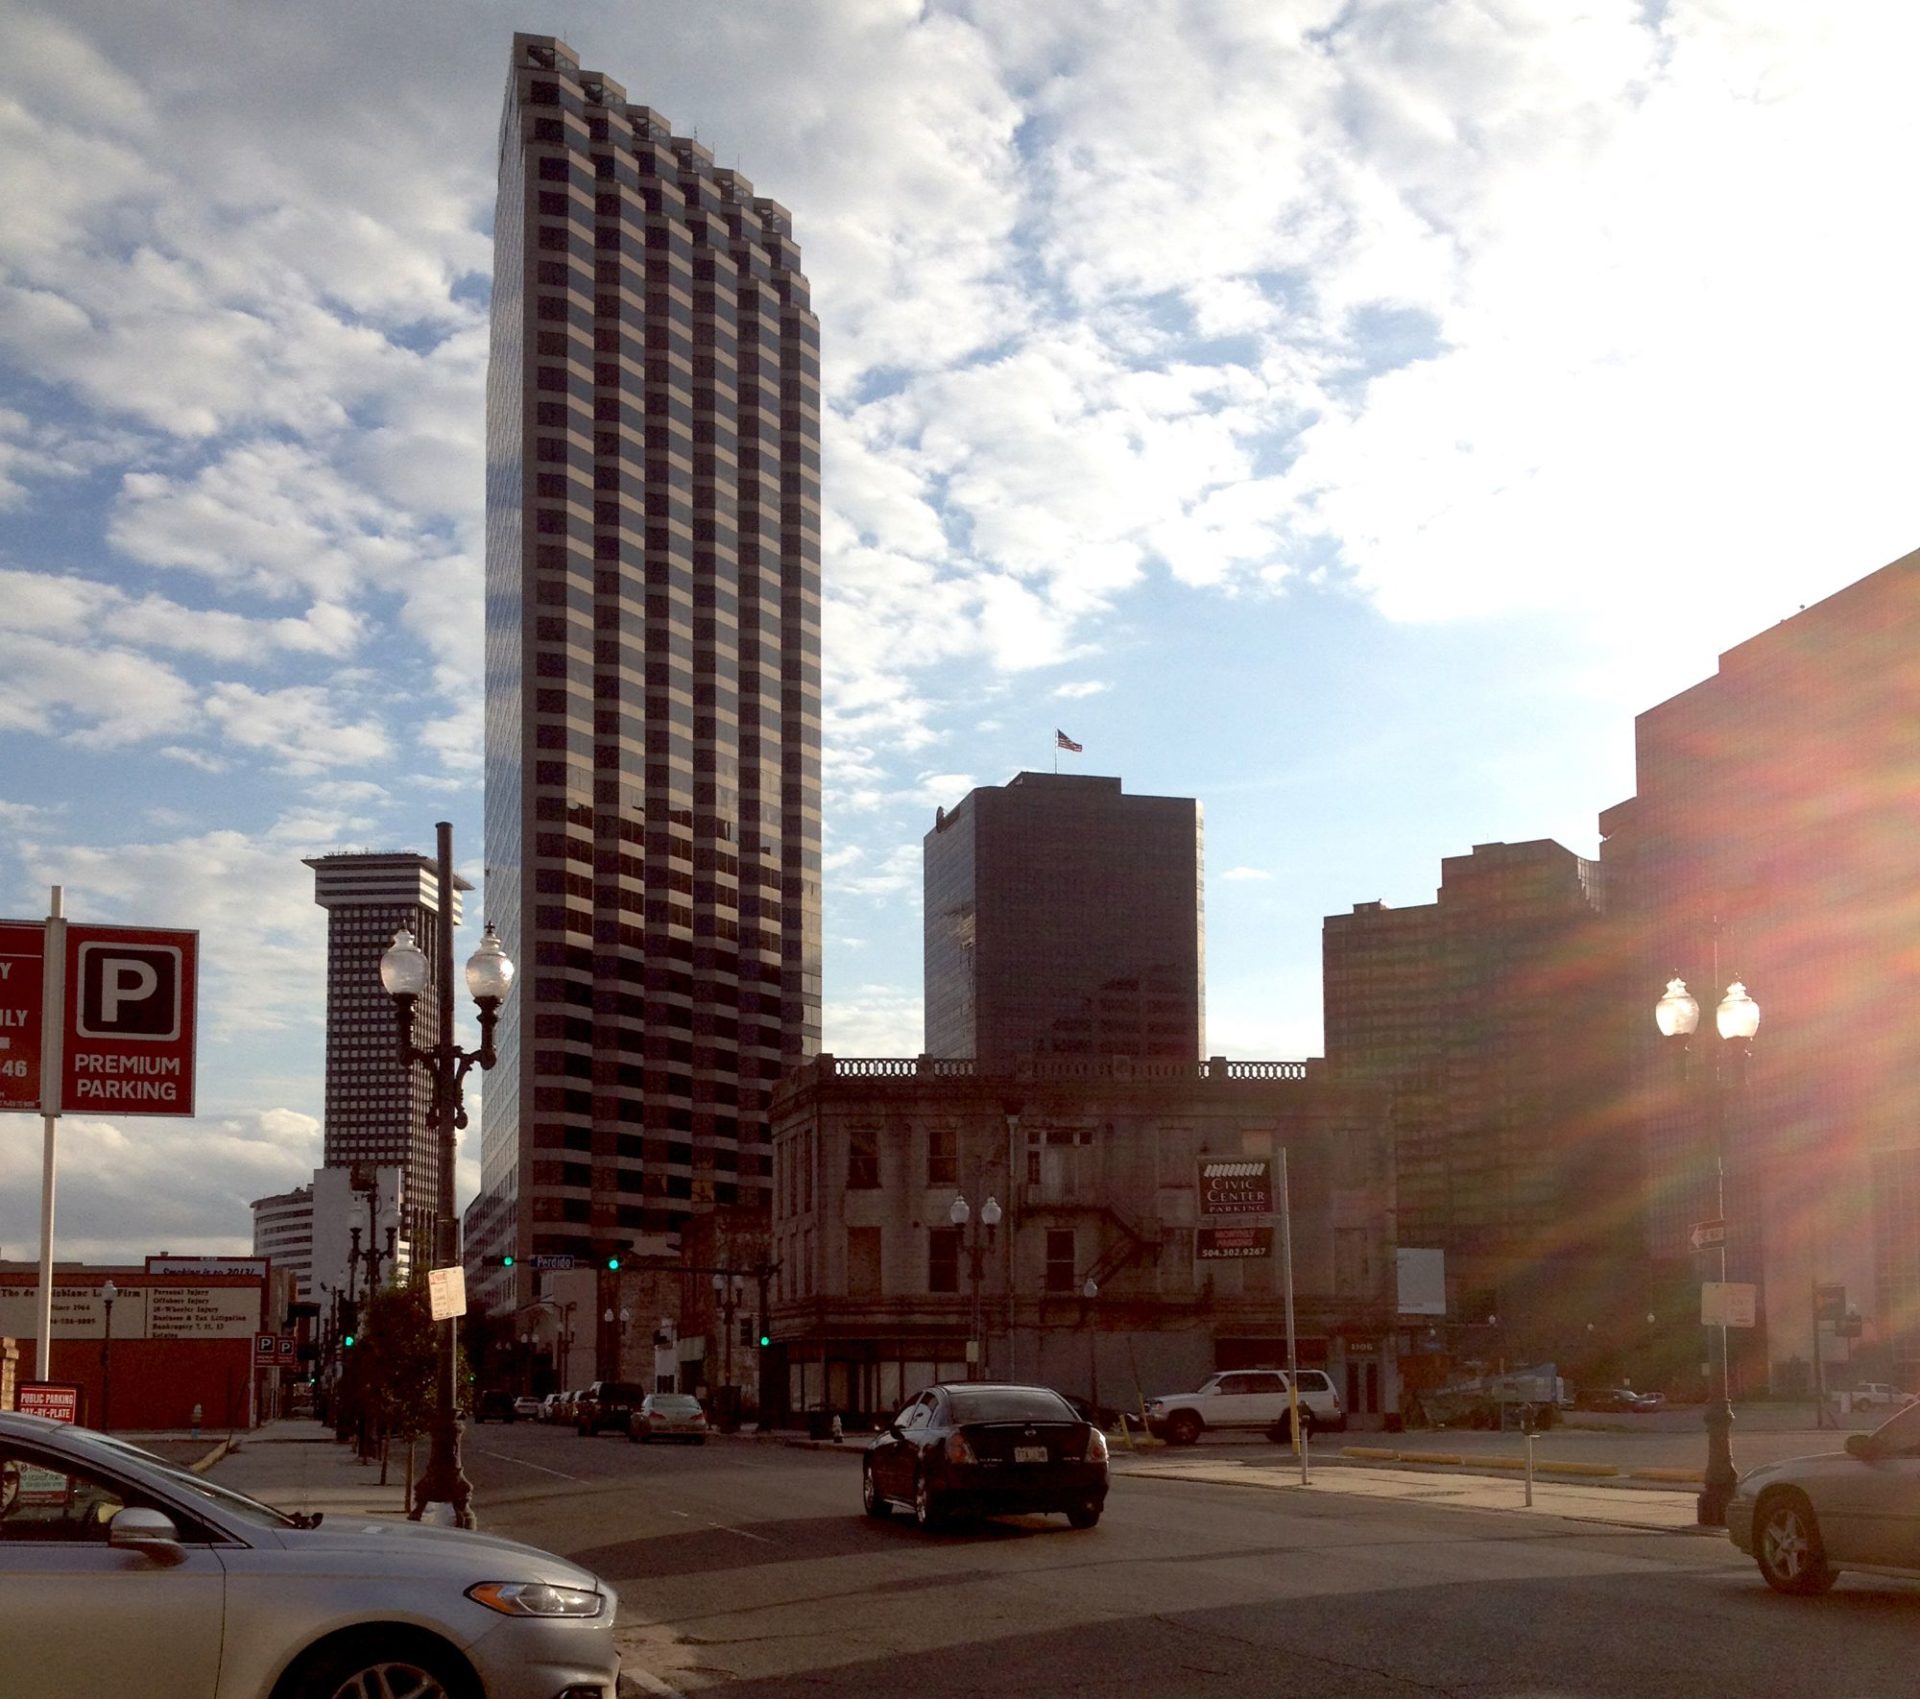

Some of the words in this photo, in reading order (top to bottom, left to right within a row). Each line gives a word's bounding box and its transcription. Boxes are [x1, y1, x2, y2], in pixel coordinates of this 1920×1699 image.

[101, 958, 158, 1022] P
[74, 1053, 180, 1075] PREMIUM
[77, 1079, 176, 1100] PARKING
[1211, 1178, 1253, 1190] CIVIC
[1207, 1189, 1265, 1202] CENTER
[1209, 1204, 1265, 1212] PARKING
[1202, 1248, 1266, 1257] 504.302.9267
[537, 1255, 571, 1268] Perdido
[117, 1288, 141, 1297] Firm
[187, 1289, 209, 1297] Injury
[187, 1298, 209, 1306] Injury
[197, 1306, 219, 1314] Injury
[261, 1338, 272, 1350] P
[281, 1342, 291, 1353] P
[20, 1392, 45, 1404] PUBLIC
[45, 1393, 74, 1405] PARKING
